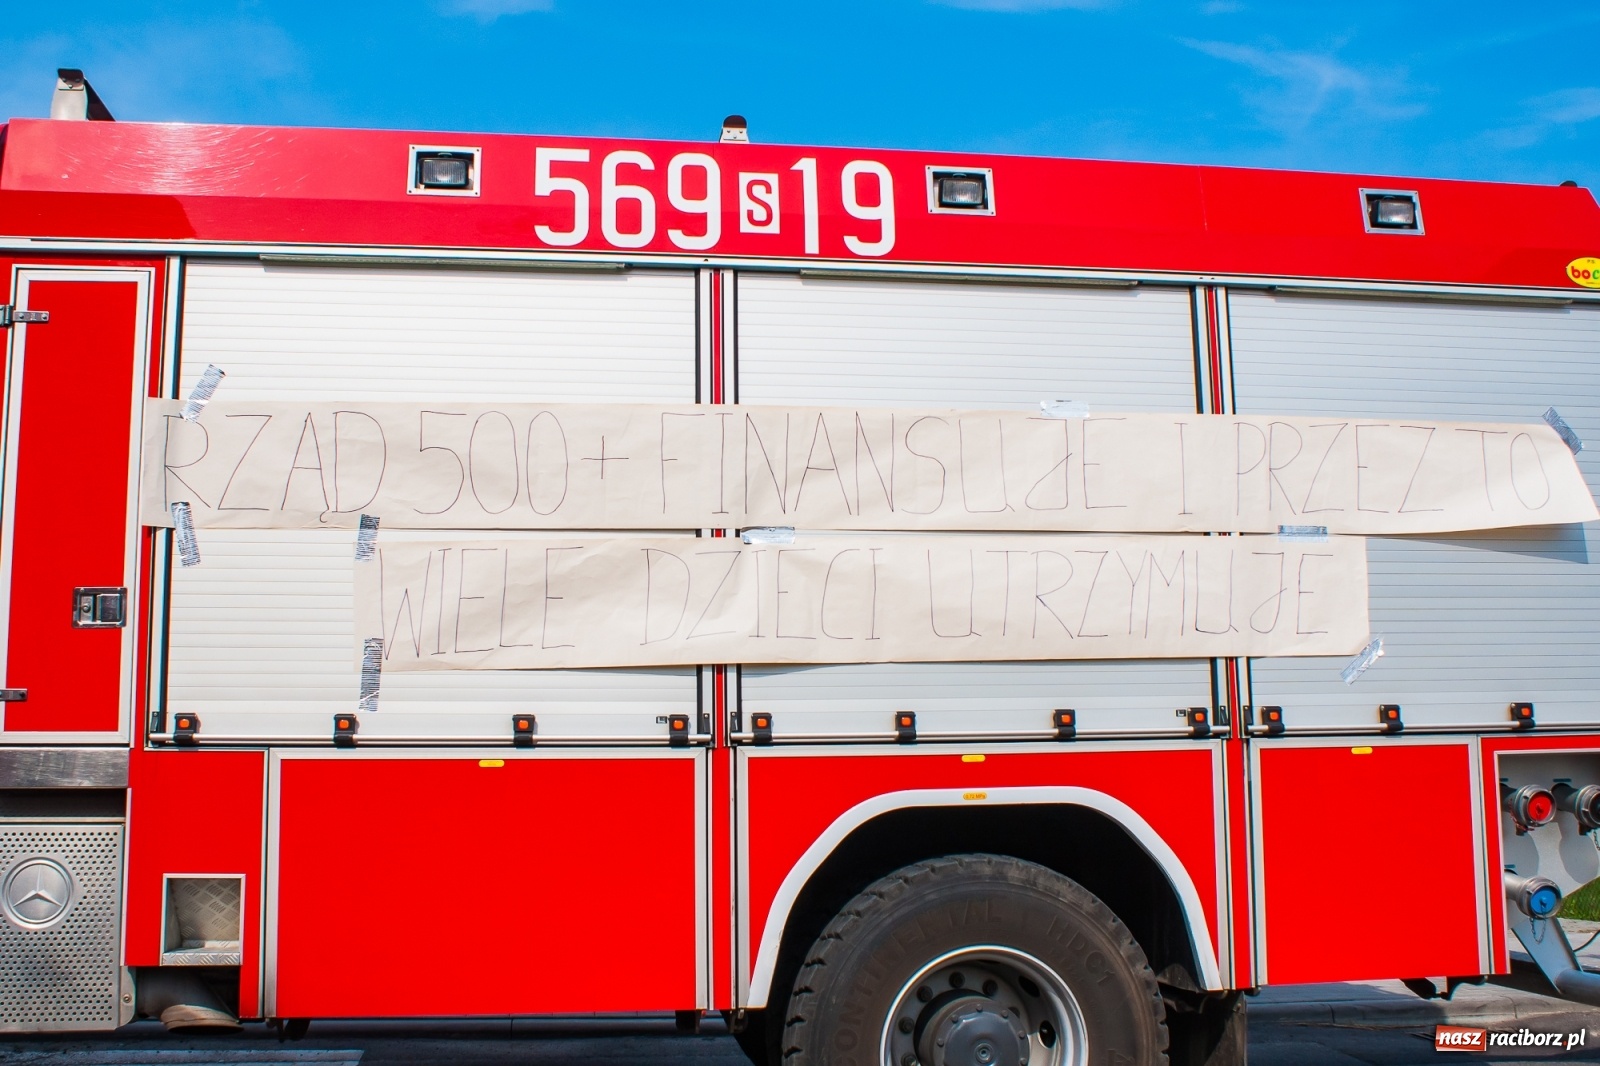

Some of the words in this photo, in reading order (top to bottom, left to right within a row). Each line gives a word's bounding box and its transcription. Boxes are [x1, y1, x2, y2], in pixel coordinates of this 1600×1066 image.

[534, 146, 721, 250] 569
[745, 179, 773, 227] S
[790, 157, 895, 257] 19
[163, 411, 386, 523] RZĄD
[661, 411, 1128, 516] FINANSUJE
[1174, 422, 1193, 515] I
[1233, 421, 1444, 516] PRZEZ
[1454, 428, 1551, 511] TO
[379, 546, 584, 660] WIELE
[640, 547, 884, 646] DZIECI
[927, 549, 1334, 640] UTRZYMUJE
